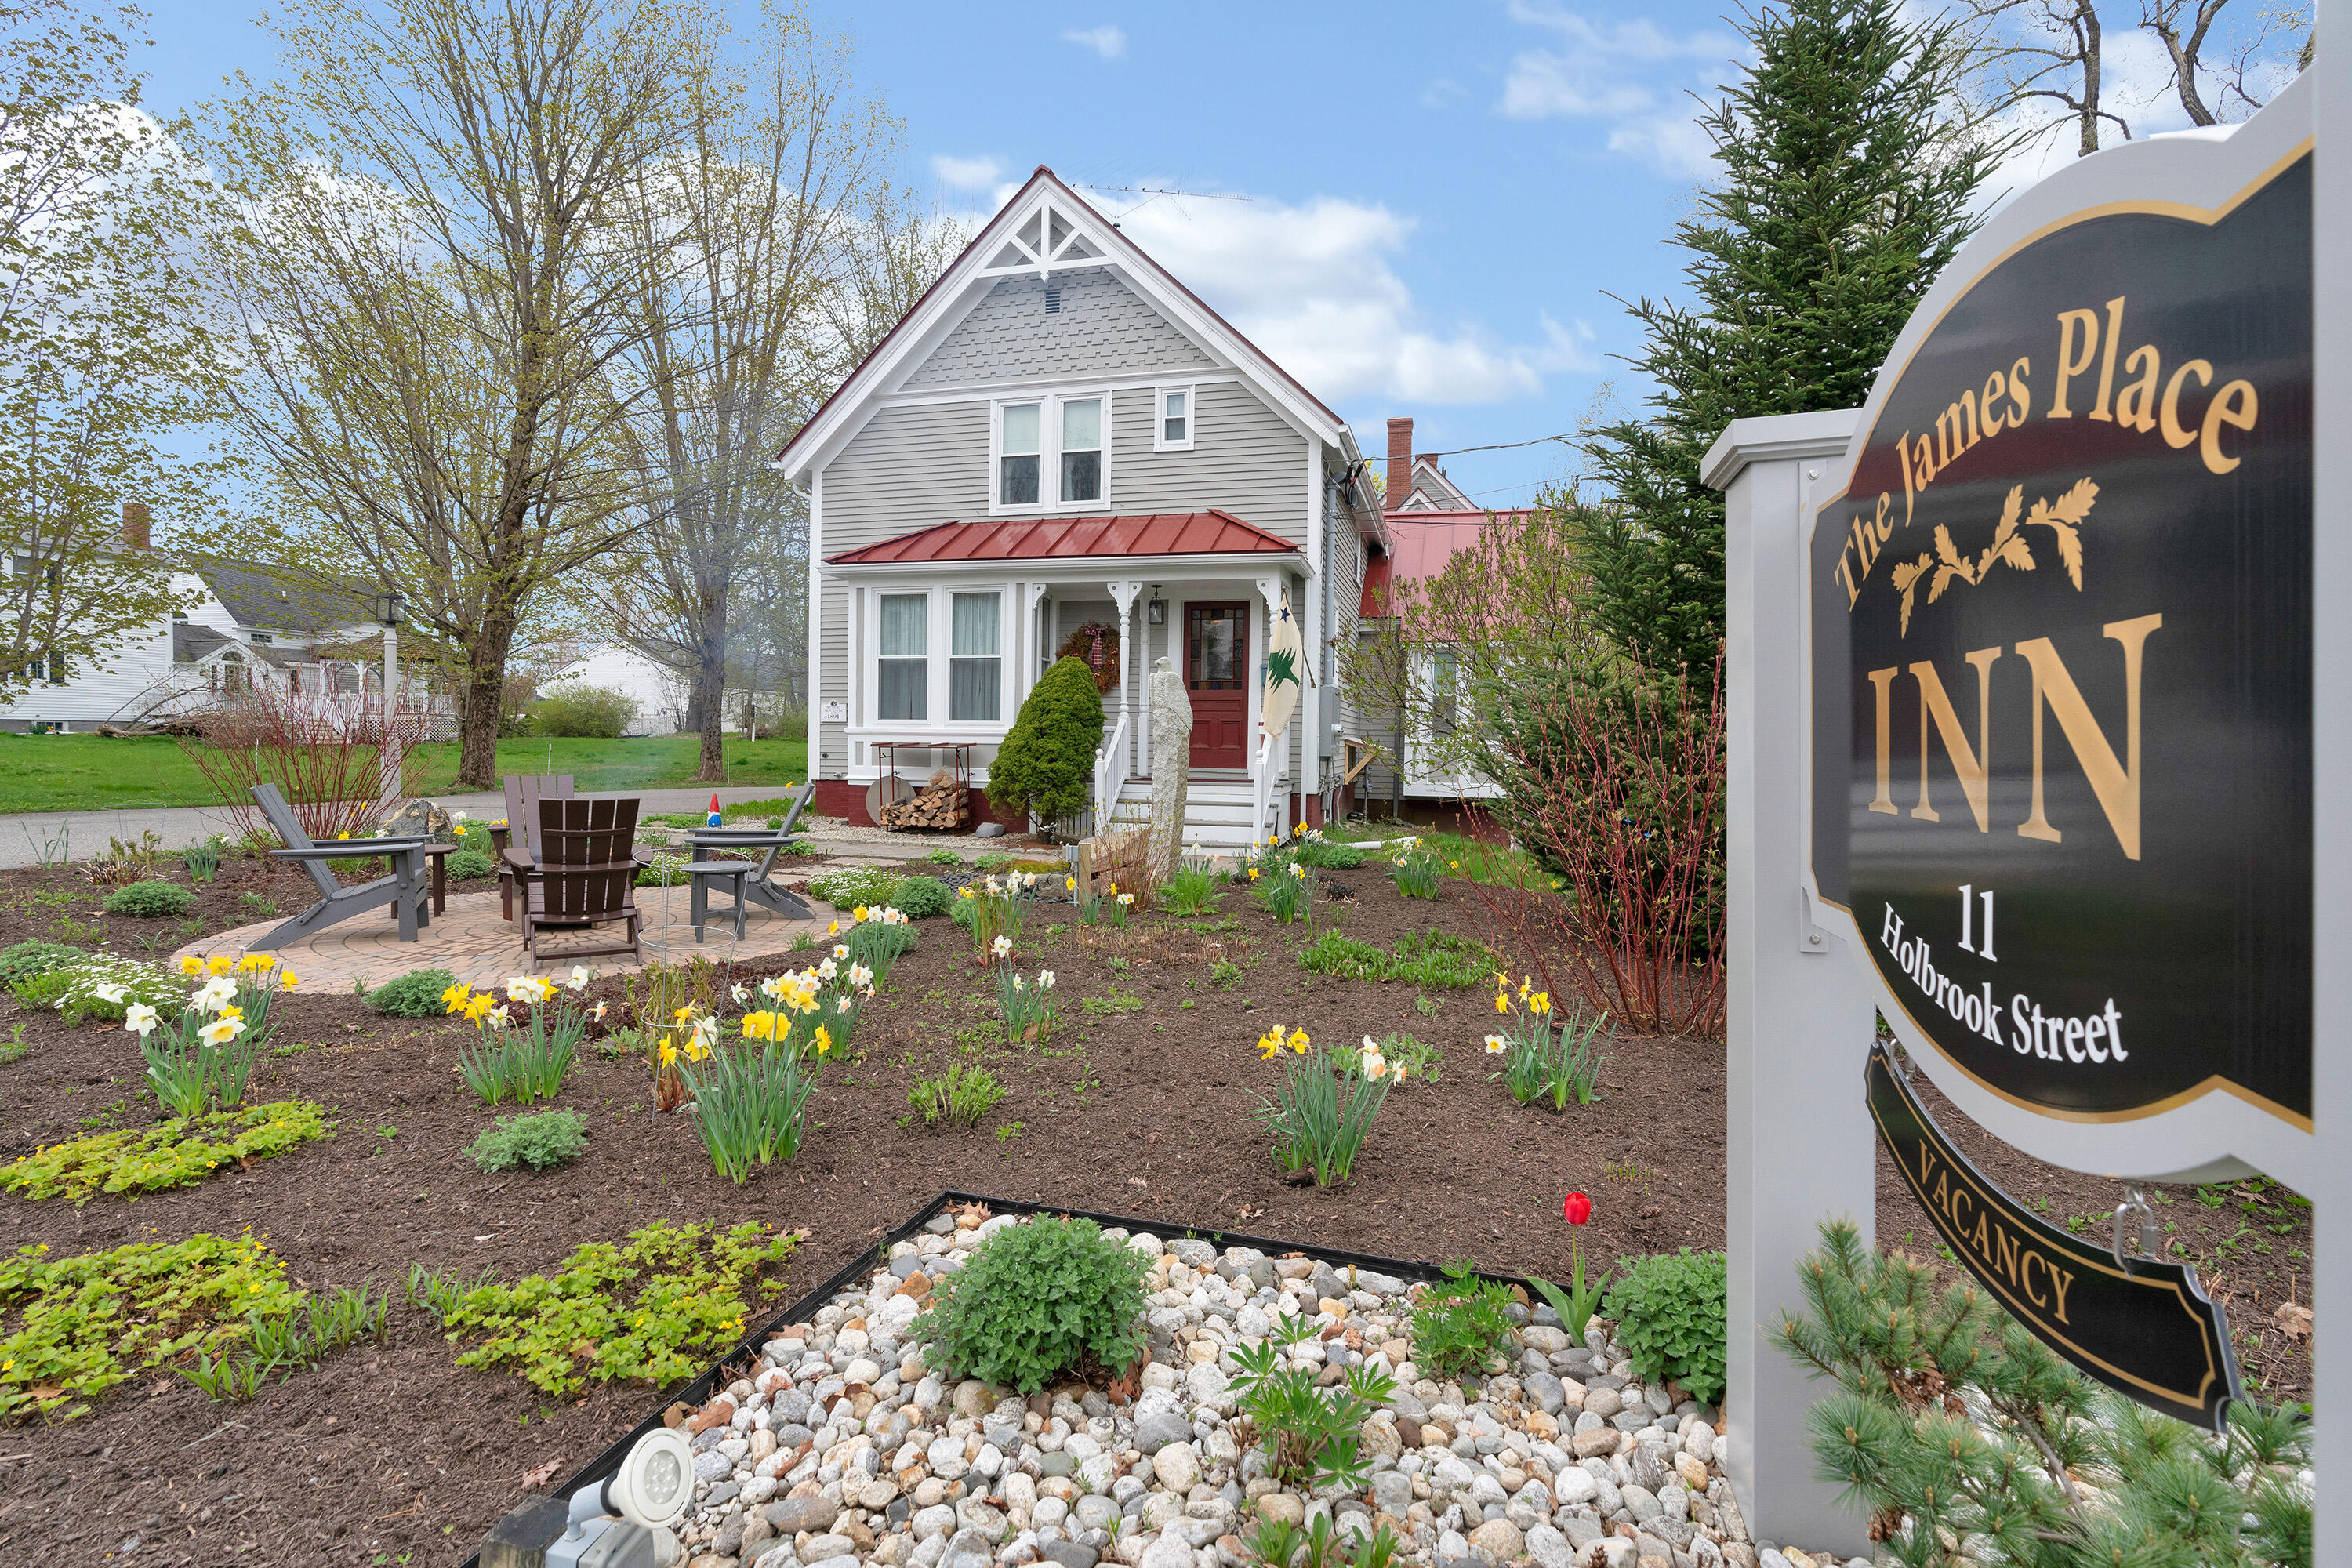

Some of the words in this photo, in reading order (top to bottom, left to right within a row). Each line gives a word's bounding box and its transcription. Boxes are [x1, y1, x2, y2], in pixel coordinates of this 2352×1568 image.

[1835, 491, 1893, 612] The
[1896, 356, 2031, 528] James
[2047, 295, 2259, 475] Place
[1868, 613, 2162, 862] INN
[1880, 902, 2004, 1046] Holbrook
[2011, 993, 2129, 1065] Street
[1958, 884, 1998, 962] 11
[1919, 1139, 2074, 1325] VACANCY
